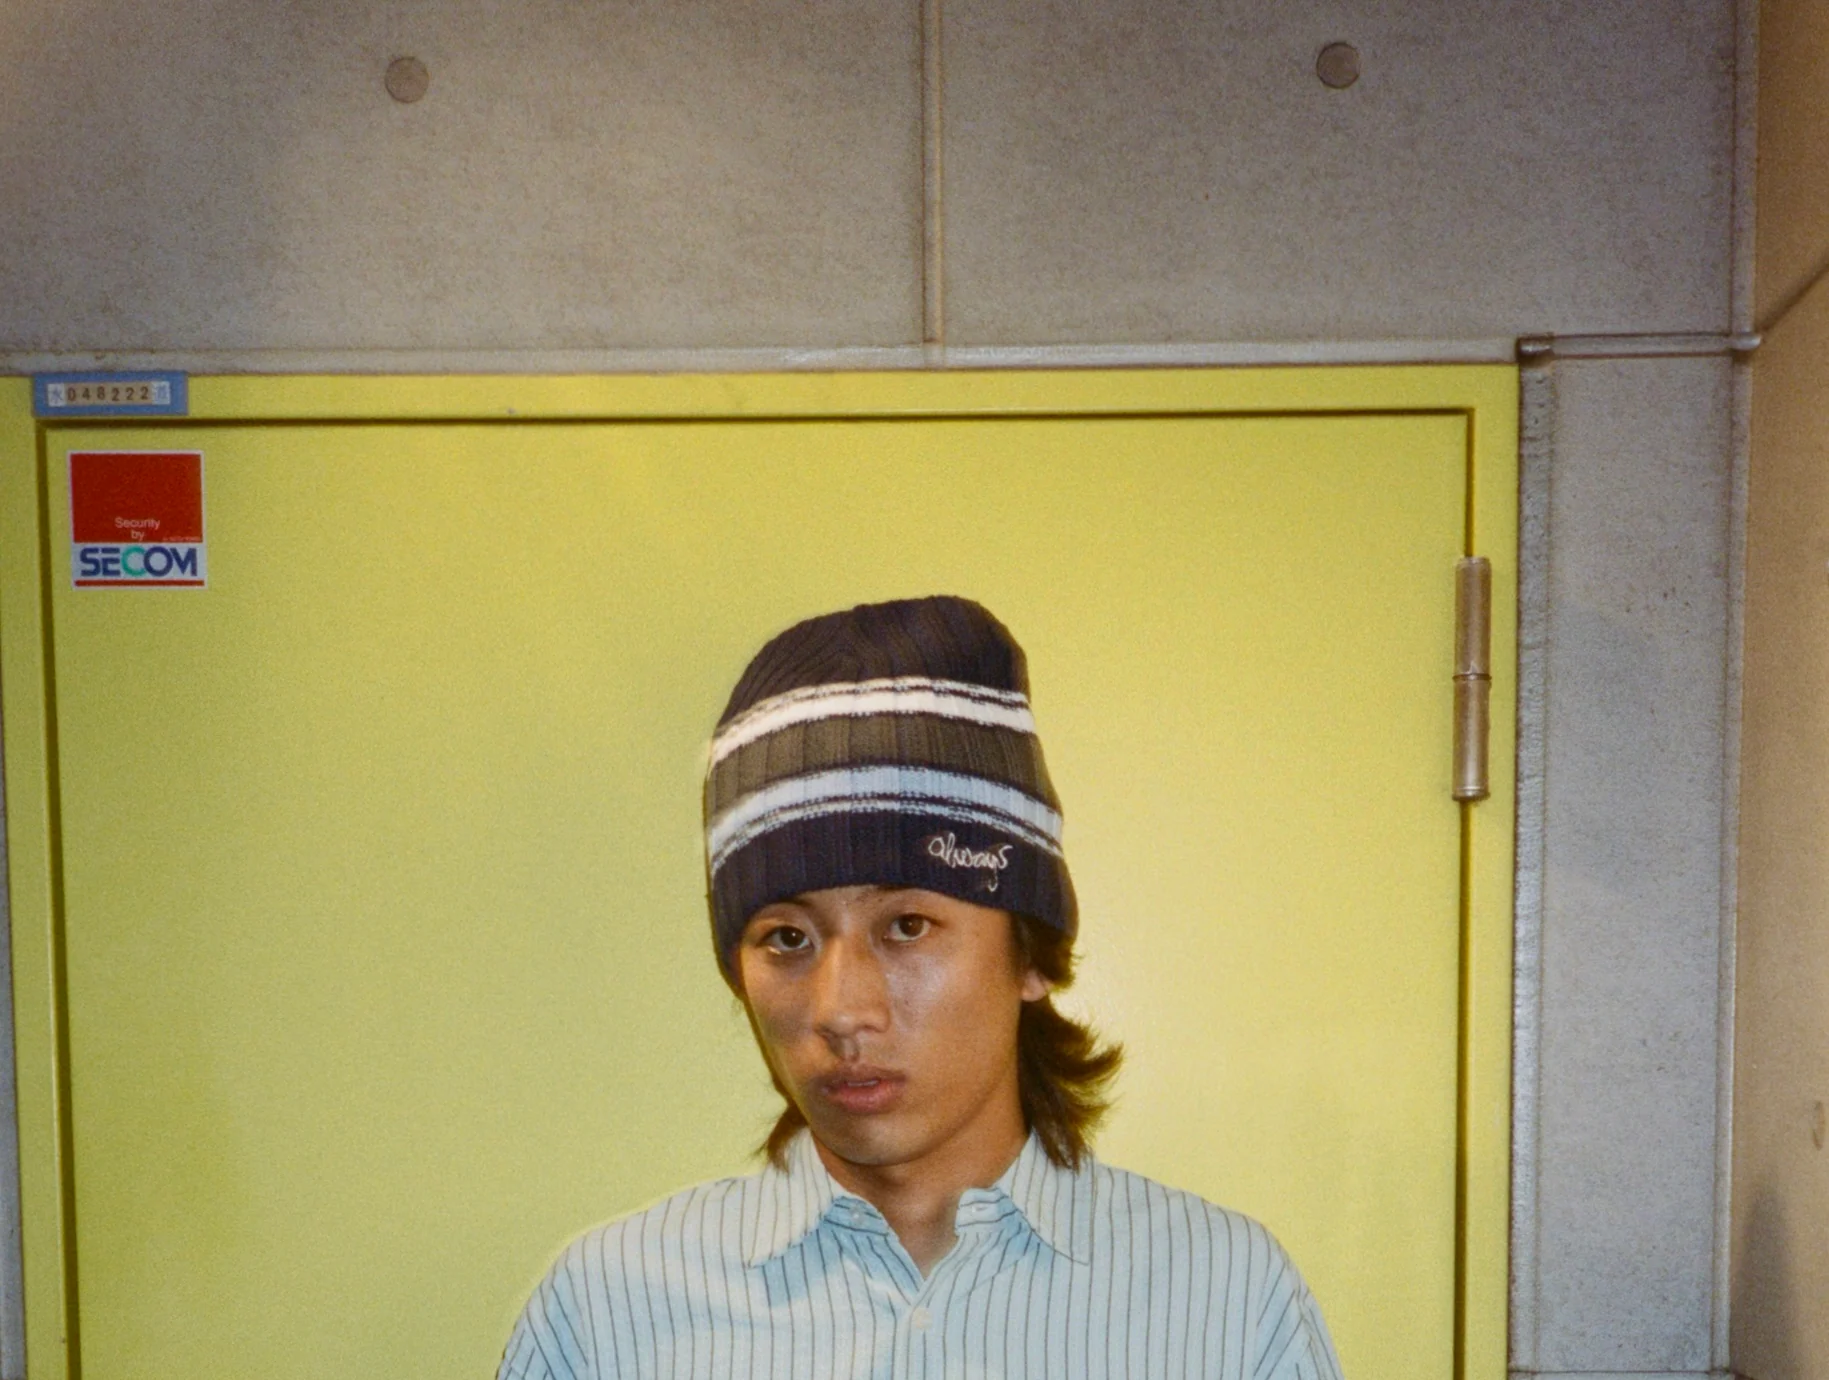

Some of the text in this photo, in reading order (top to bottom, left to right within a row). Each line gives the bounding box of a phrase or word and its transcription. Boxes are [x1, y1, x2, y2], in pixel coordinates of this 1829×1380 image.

[115, 517, 161, 530] Security
[130, 529, 145, 541] by
[80, 545, 198, 577] SECOM
